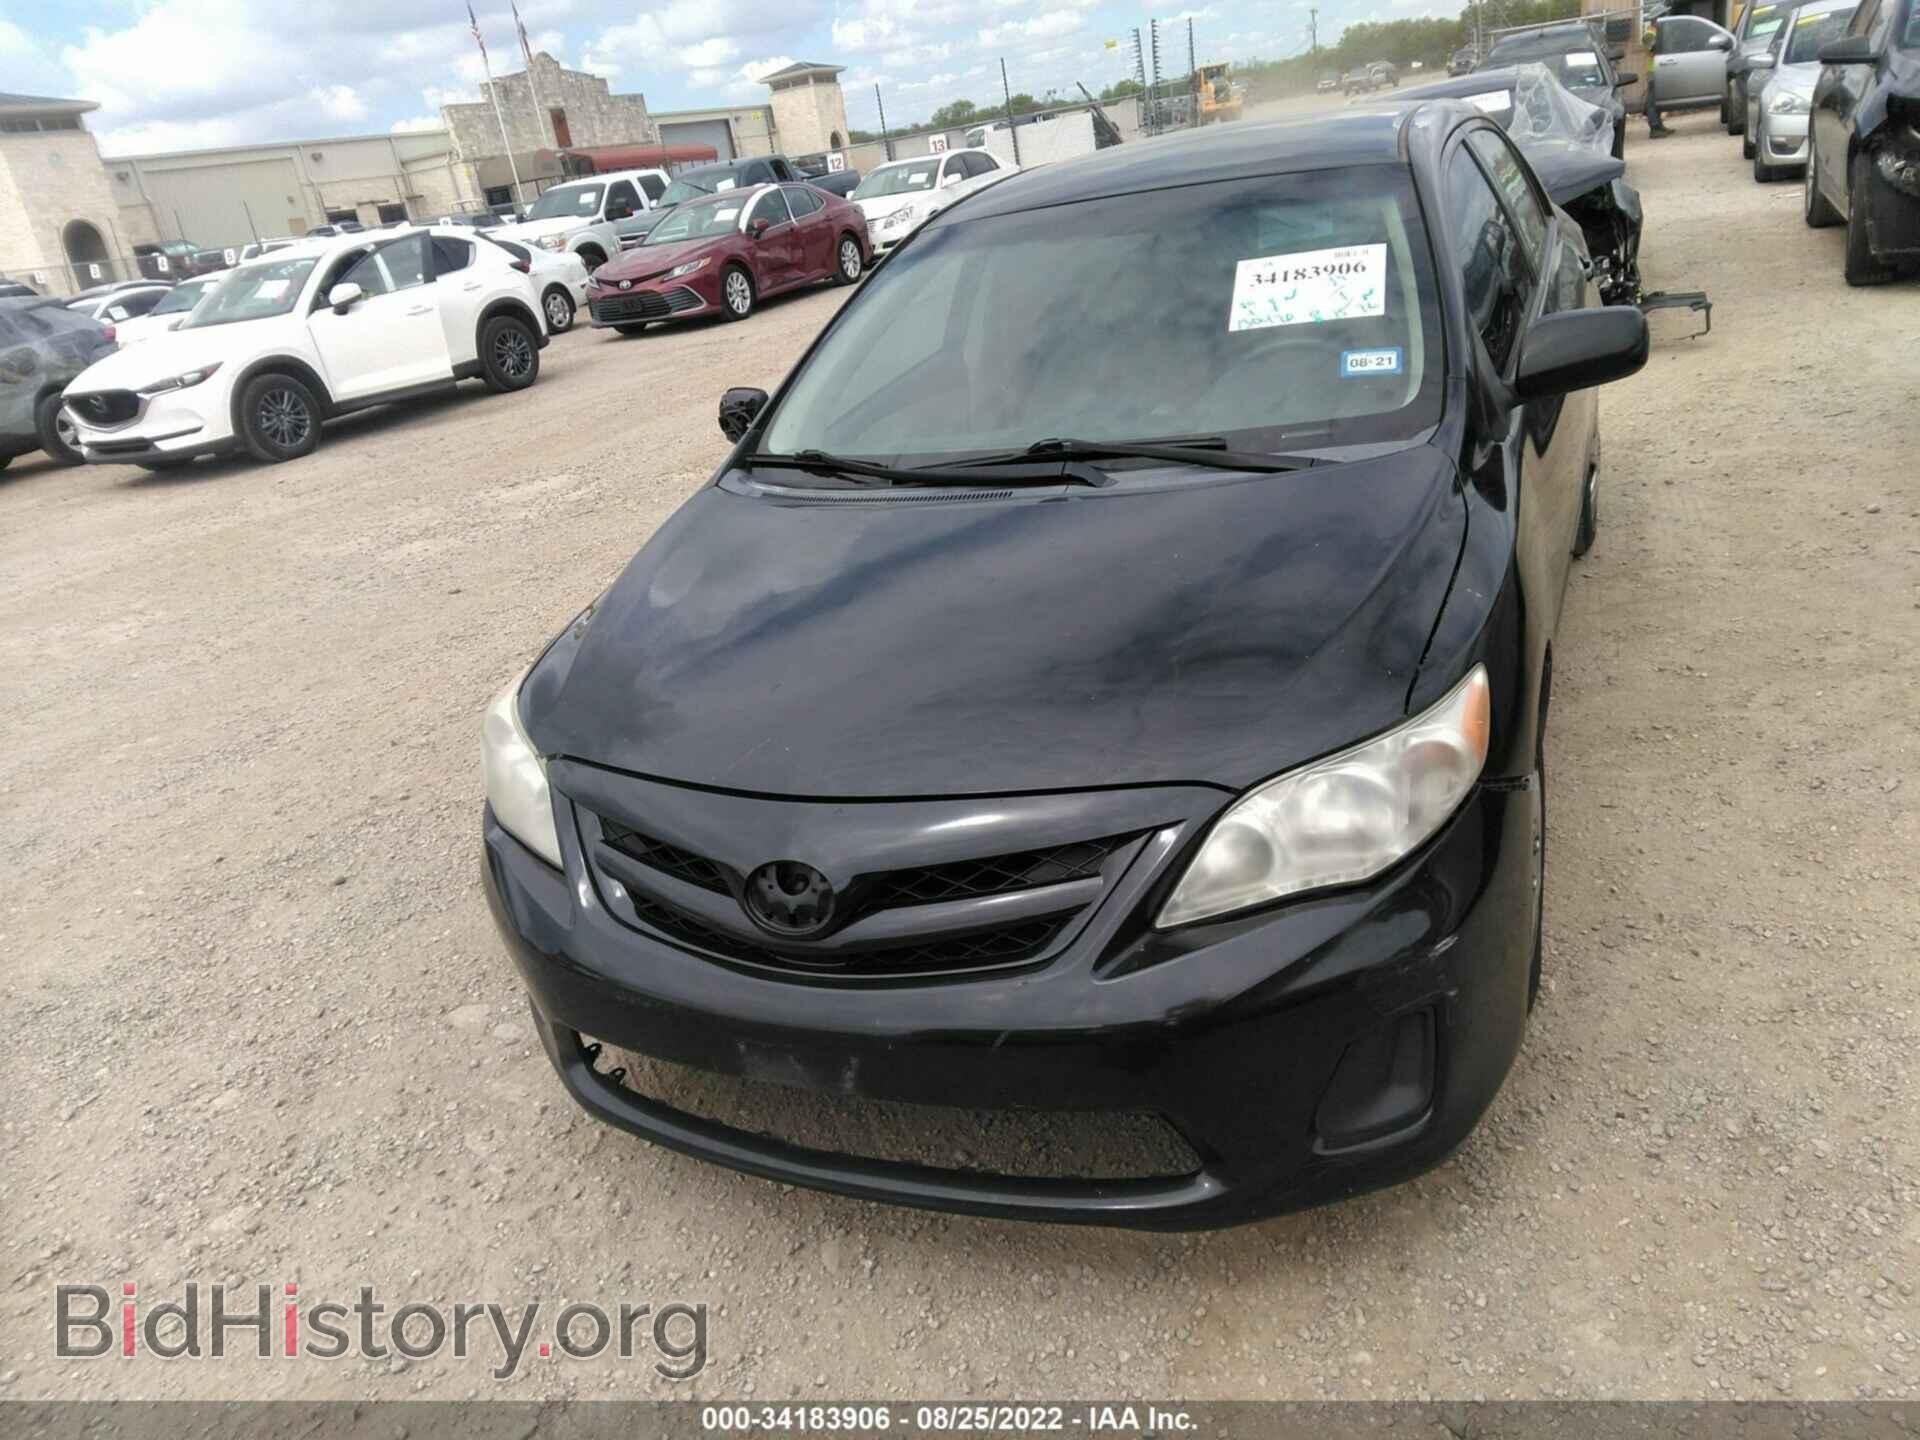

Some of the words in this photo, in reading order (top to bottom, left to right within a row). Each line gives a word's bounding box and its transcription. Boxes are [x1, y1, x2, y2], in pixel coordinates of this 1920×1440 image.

[931, 139, 945, 153] 13
[830, 157, 842, 170] 12
[1249, 261, 1367, 287] 34183906
